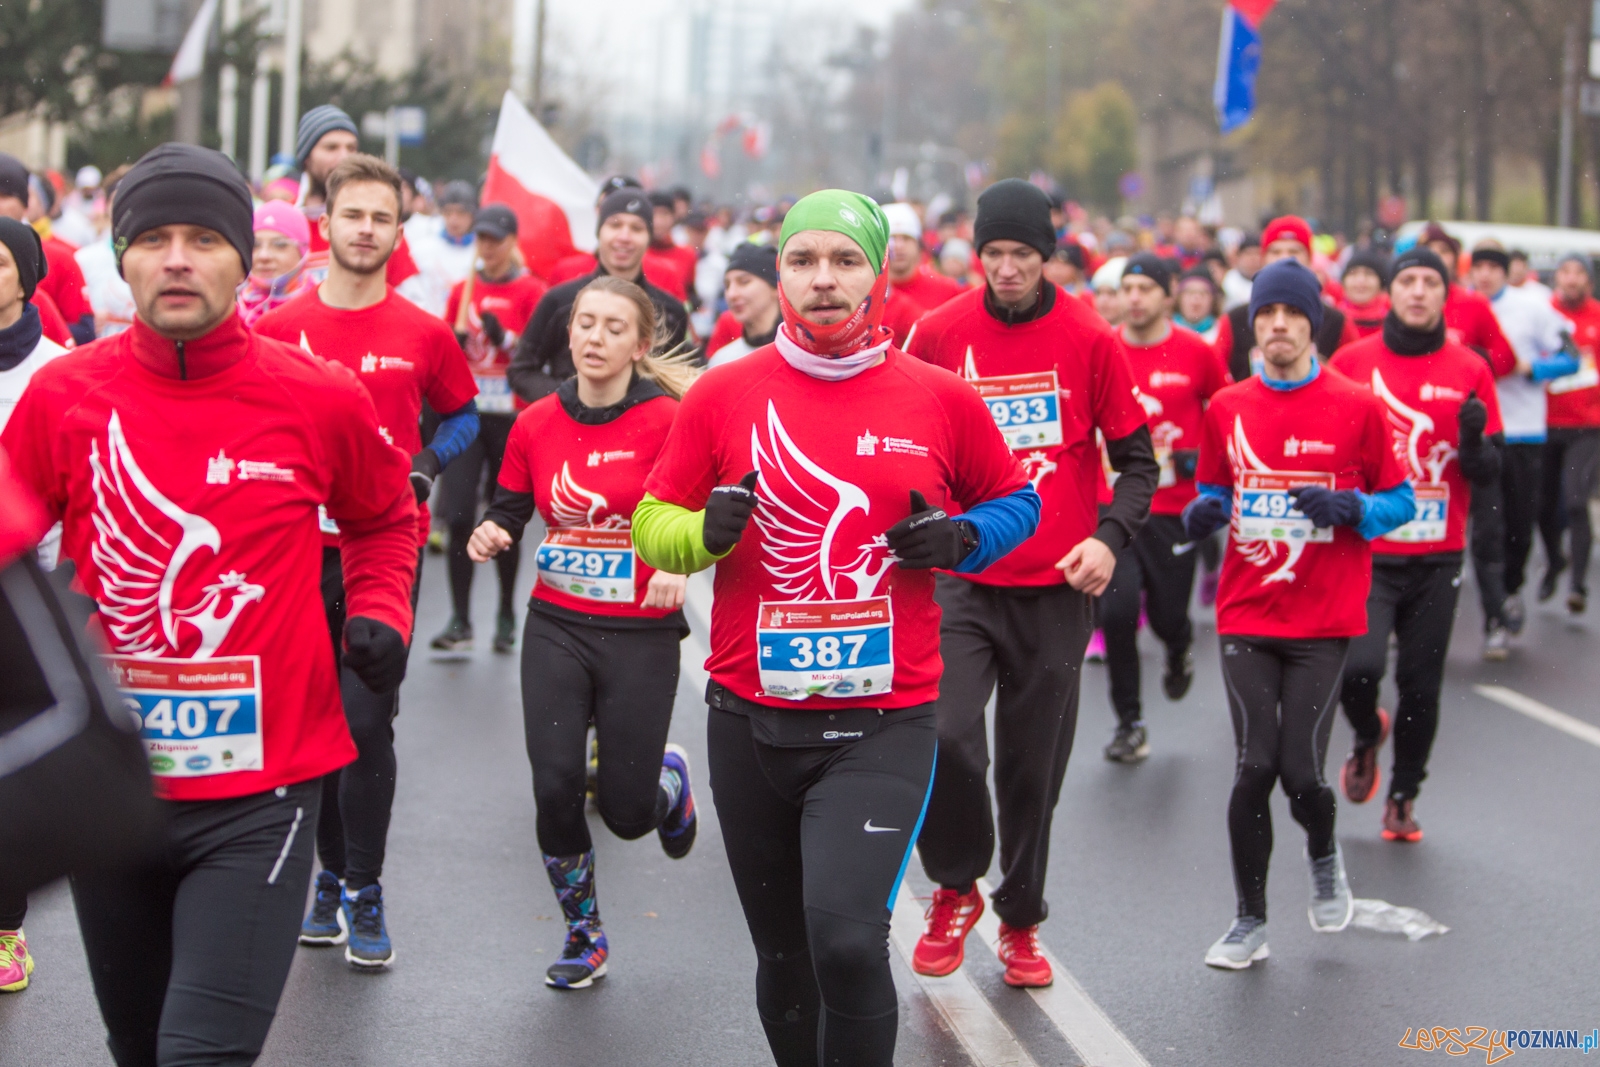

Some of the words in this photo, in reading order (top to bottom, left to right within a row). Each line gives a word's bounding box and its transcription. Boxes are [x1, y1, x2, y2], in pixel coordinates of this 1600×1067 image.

[846, 302, 868, 329] WORLD
[985, 398, 1049, 426] 933
[882, 437, 892, 452] 1
[1414, 501, 1440, 520] 72
[548, 550, 623, 577] 2297
[831, 610, 883, 621] RunPoland.org
[762, 646, 773, 657] E
[789, 634, 868, 669] 387
[811, 673, 844, 681] Mikołaj
